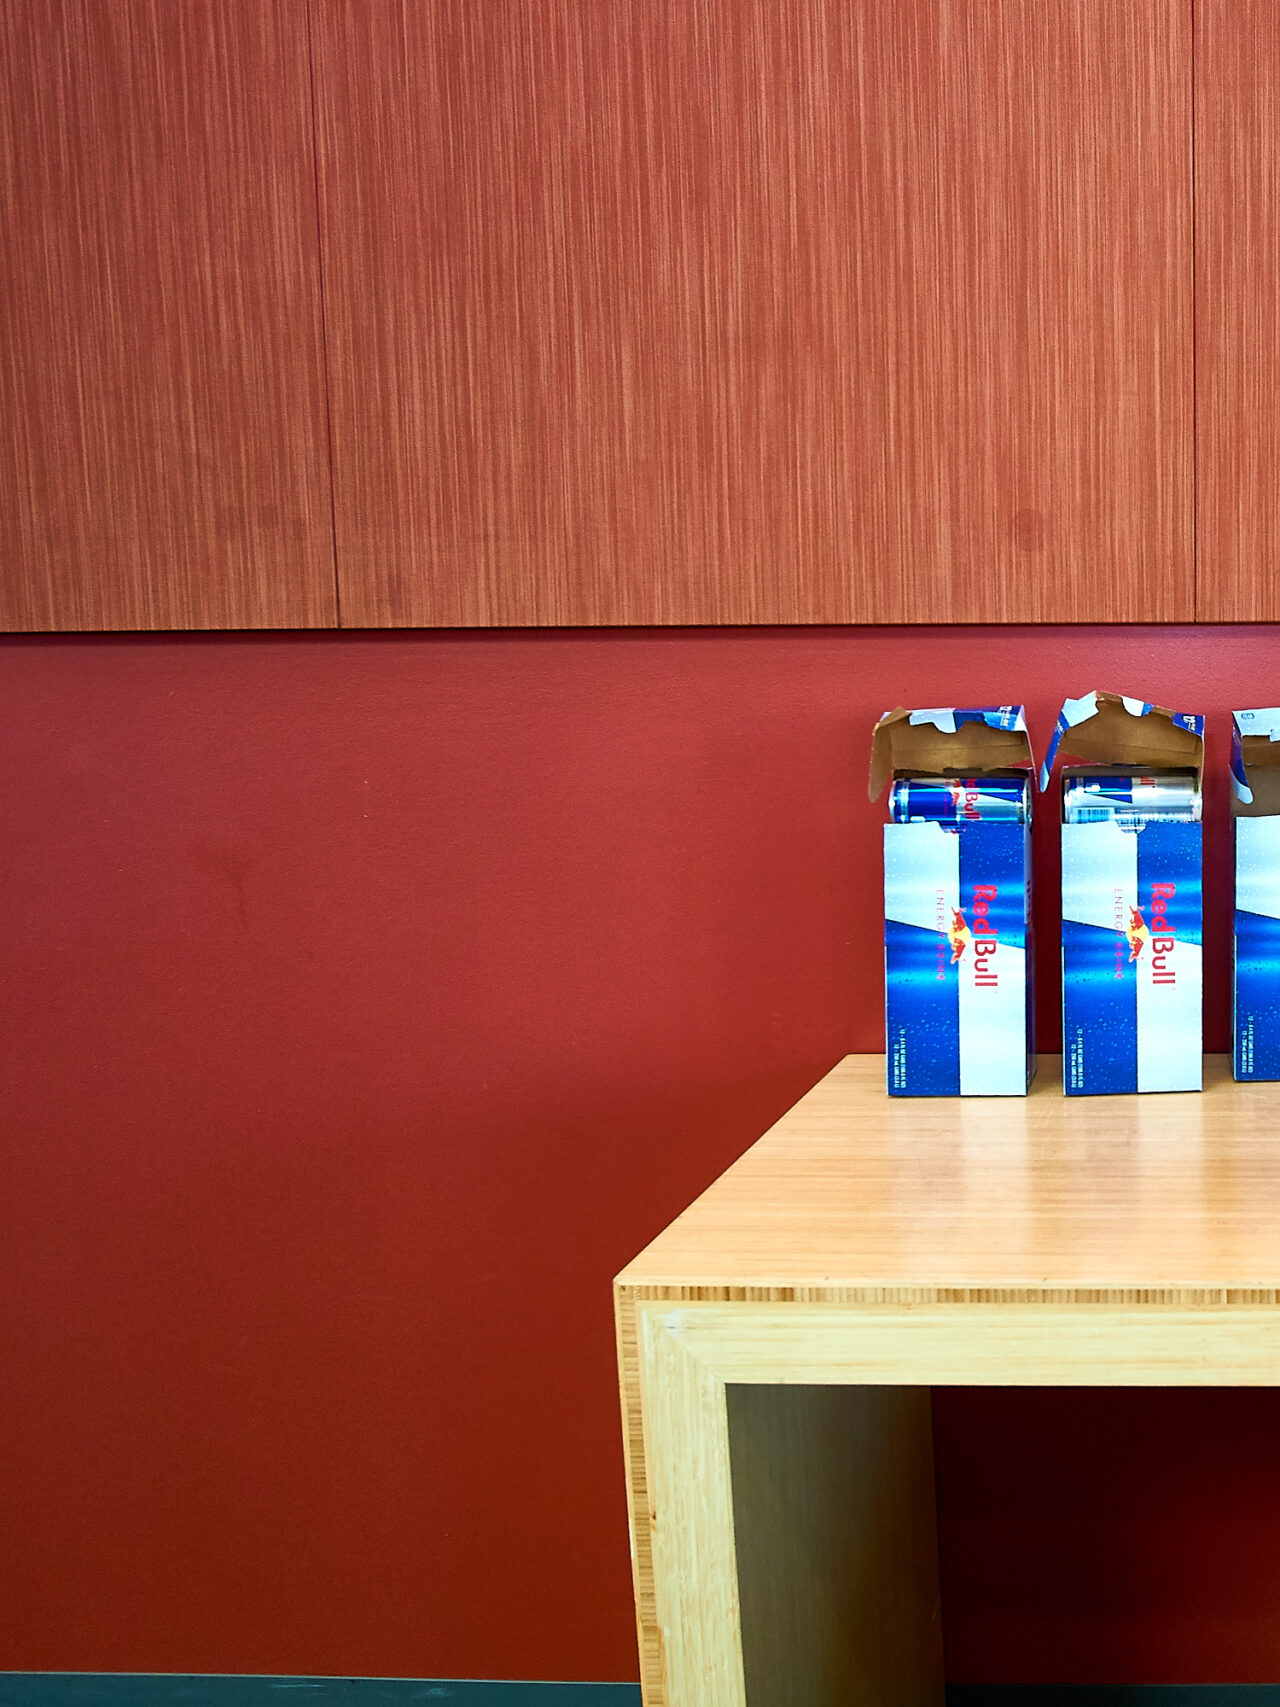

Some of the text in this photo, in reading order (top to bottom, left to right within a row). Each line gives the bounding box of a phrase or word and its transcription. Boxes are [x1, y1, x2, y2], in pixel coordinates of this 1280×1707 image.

[964, 792, 982, 819] Bull
[936, 890, 945, 981] ENERGY DRINK
[973, 885, 998, 986] Red Bull
[1115, 889, 1123, 979] ENERGY DRINK
[1151, 882, 1176, 984] Red Bull
